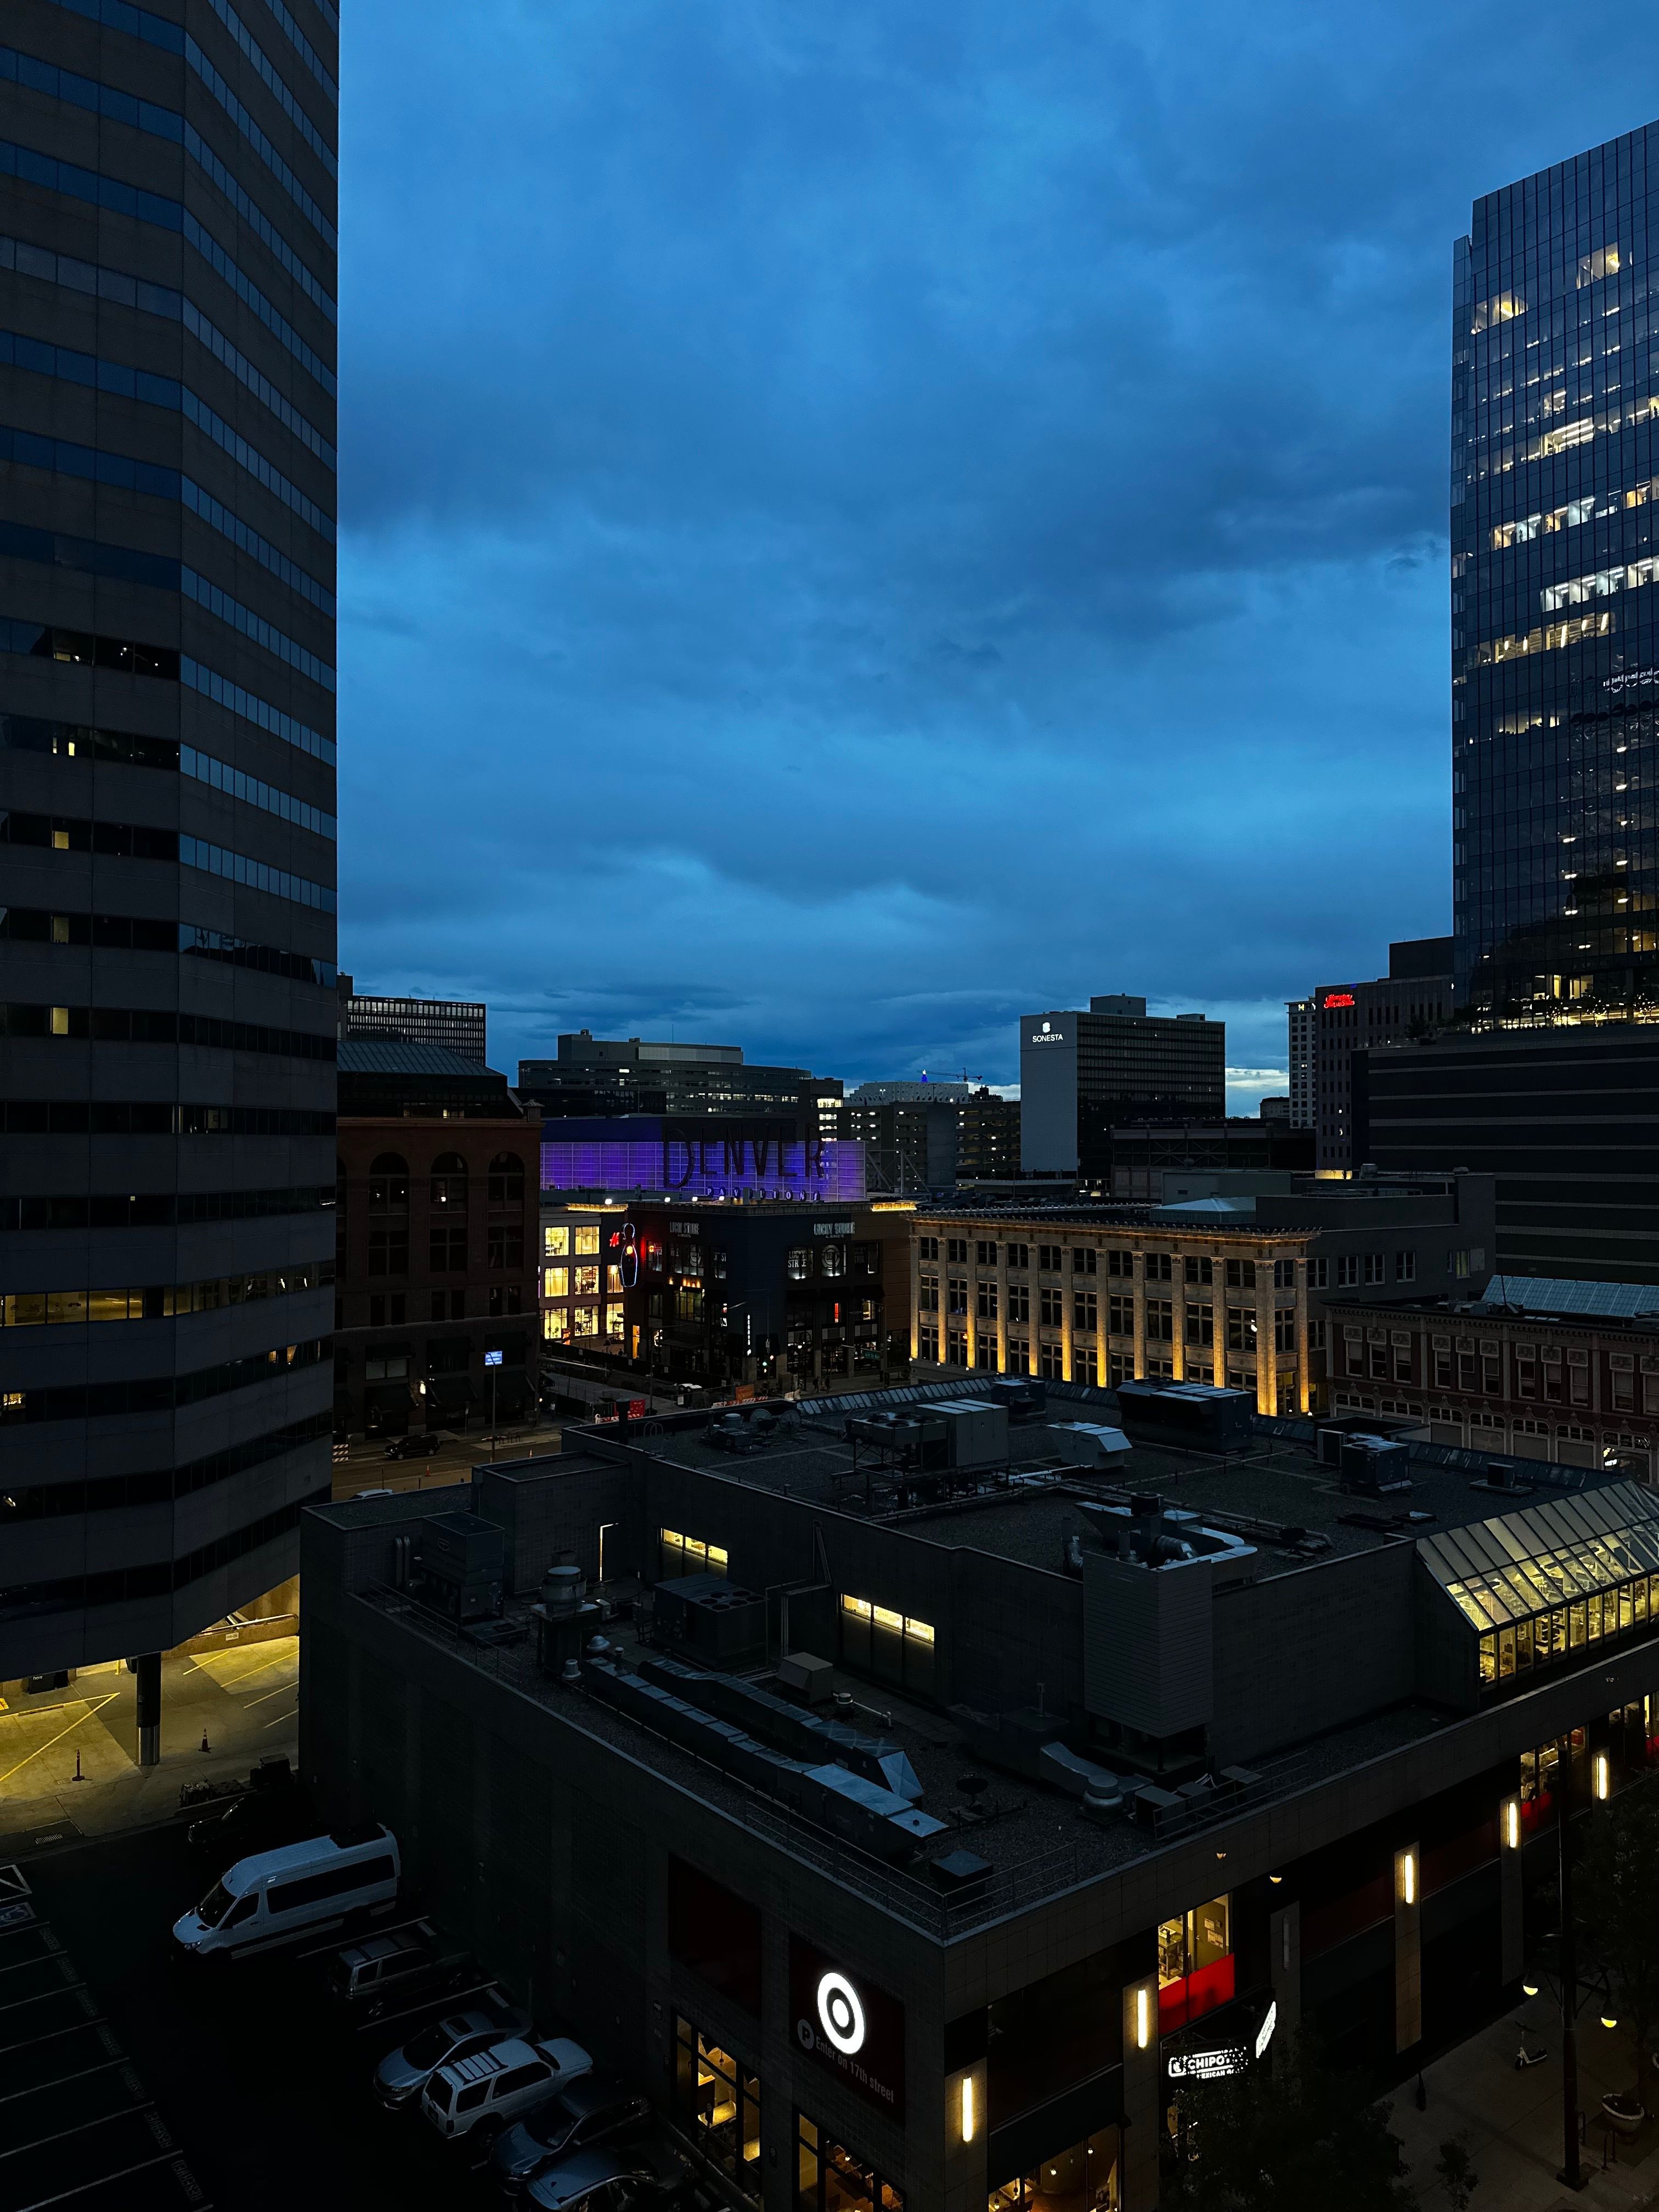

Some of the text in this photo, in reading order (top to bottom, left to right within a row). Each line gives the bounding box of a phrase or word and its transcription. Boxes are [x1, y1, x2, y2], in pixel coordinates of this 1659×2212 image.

[1032, 1034, 1063, 1042] SONESTA
[663, 1123, 823, 1188] DENVER
[707, 1187, 820, 1201] PAVLIONS
[814, 1222, 855, 1235] LUCKY STRIKE
[816, 2035, 836, 2060] Enter
[838, 2054, 847, 2070] on
[850, 2061, 867, 2084] 17th
[870, 2076, 894, 2103] street
[1188, 2053, 1239, 2070] CHIPO
[144, 2111, 176, 2149] RESERVED
[171, 2159, 206, 2203] RESERVED
